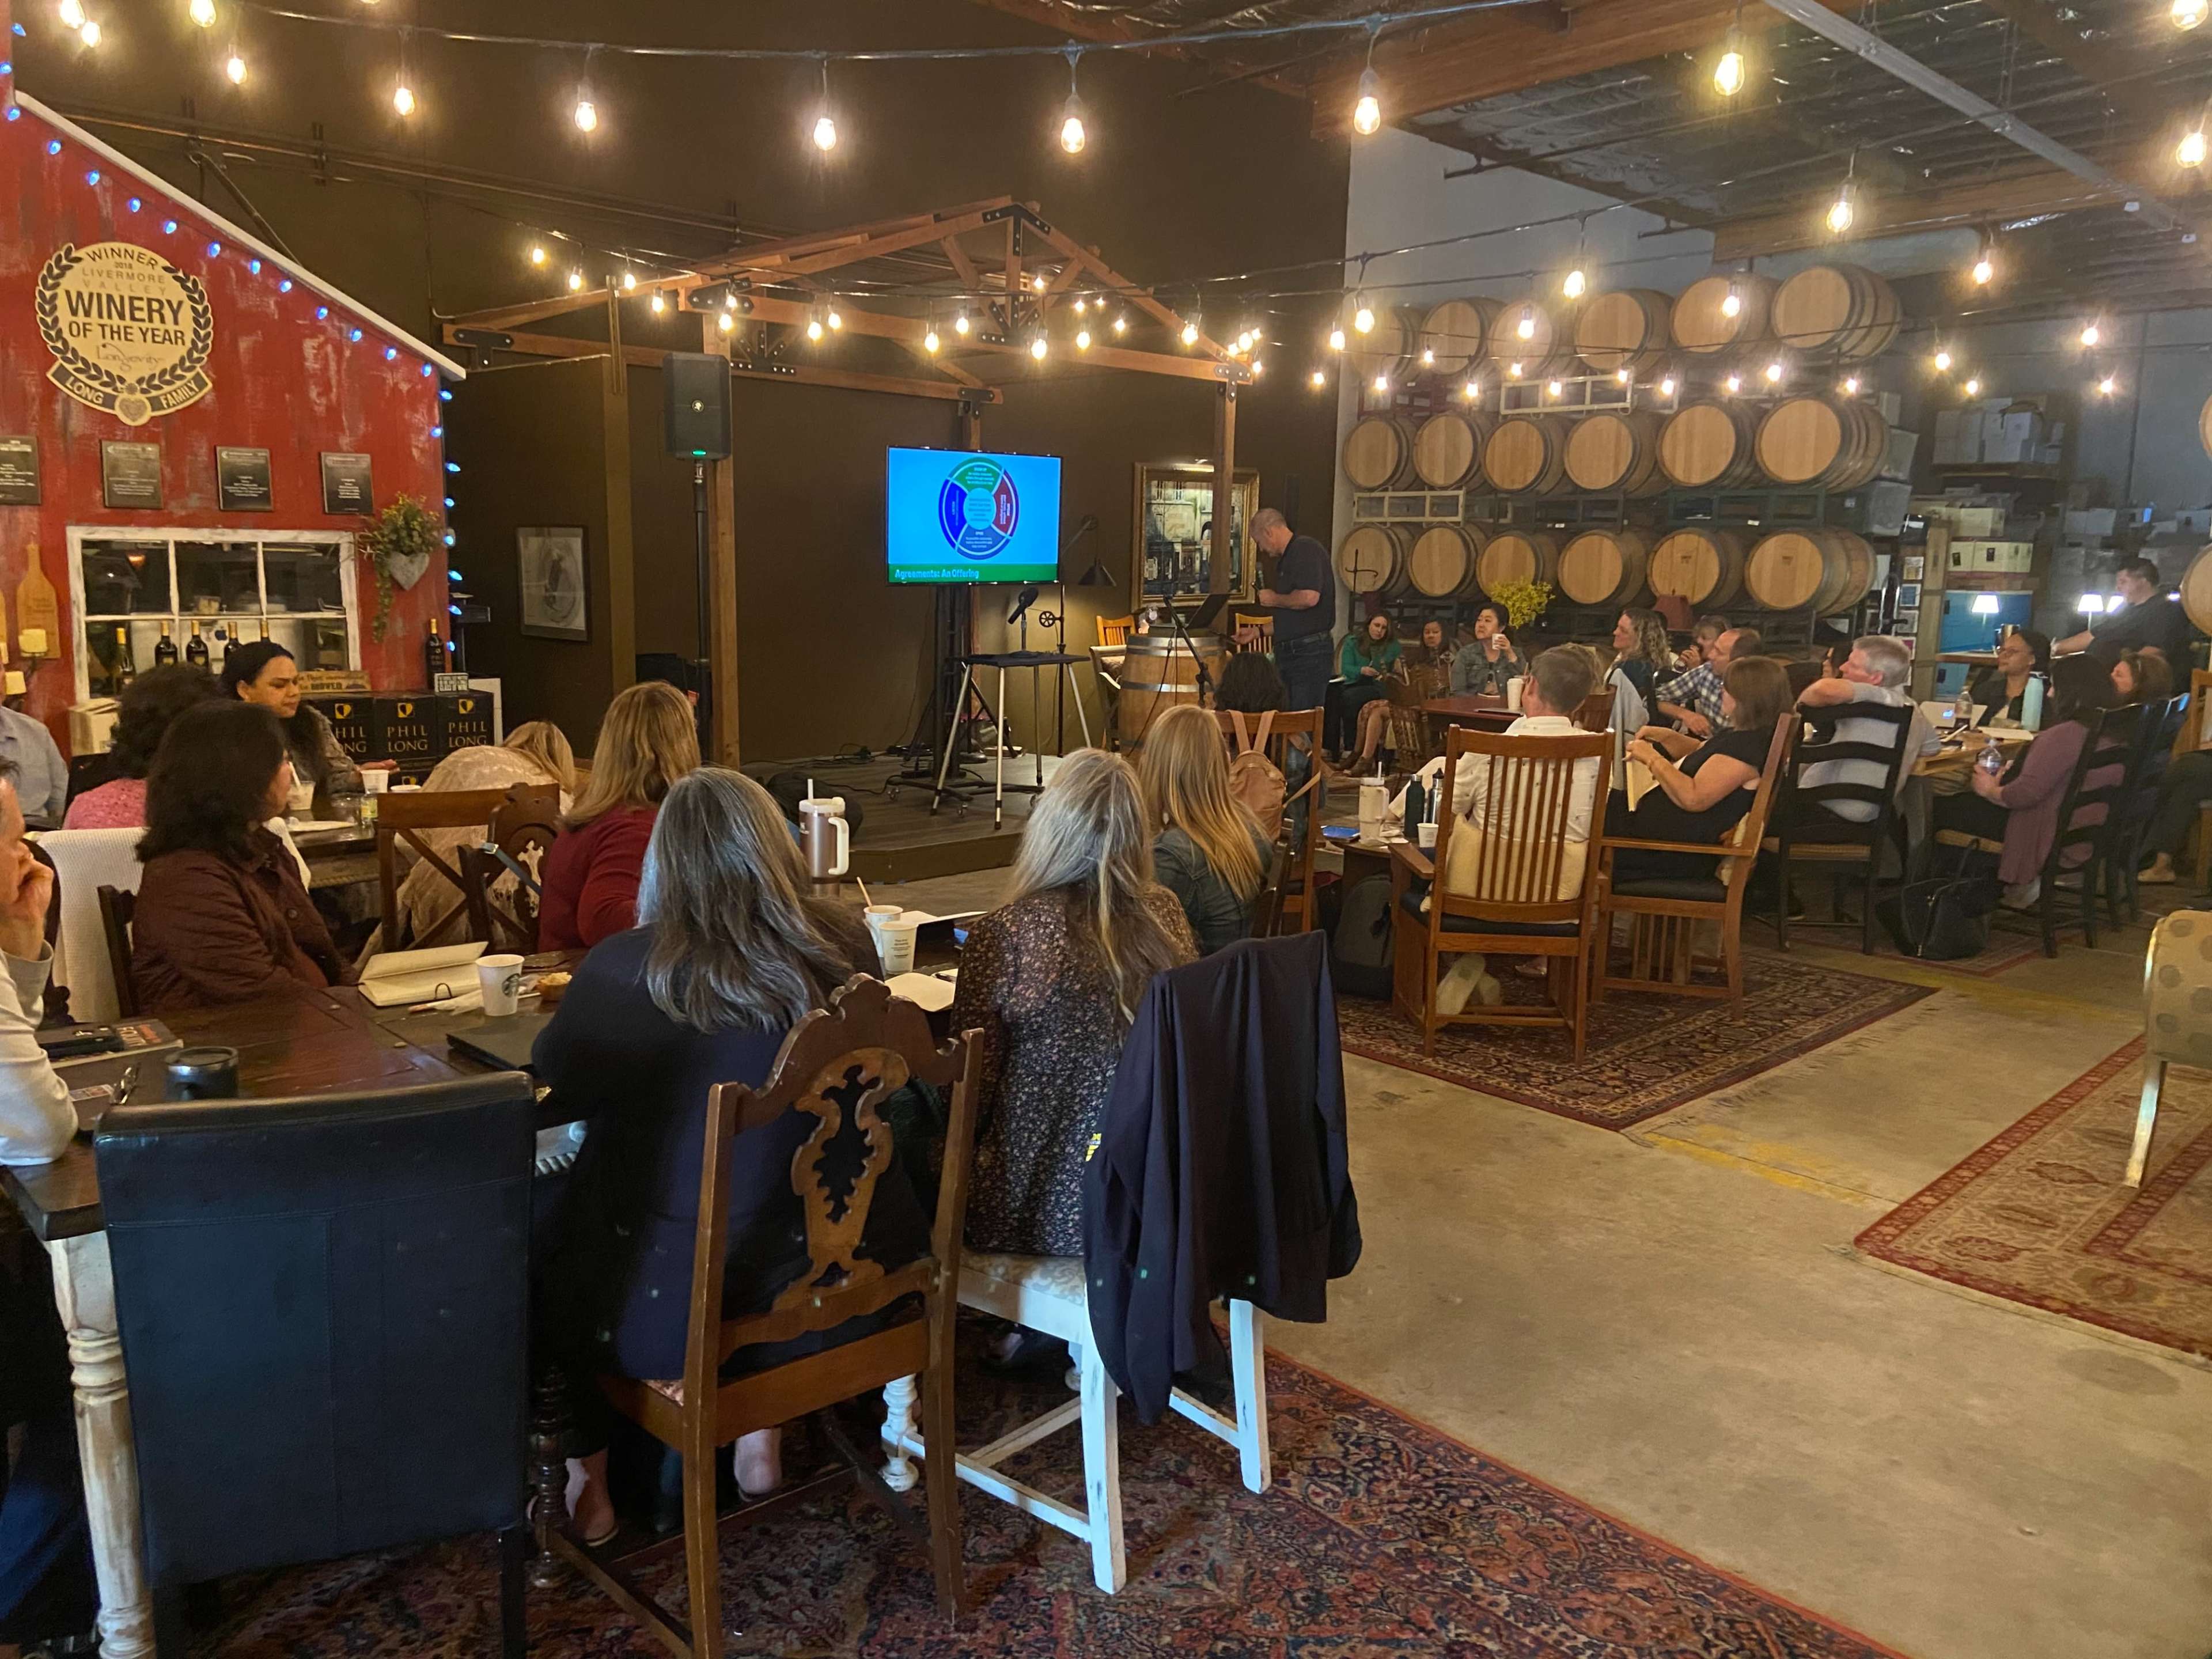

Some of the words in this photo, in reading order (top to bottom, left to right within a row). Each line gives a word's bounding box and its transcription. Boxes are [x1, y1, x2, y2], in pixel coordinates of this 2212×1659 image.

[85, 247, 158, 270] WINNER
[82, 267, 165, 283] LIVERMORE
[82, 279, 166, 296] VALLEY
[65, 289, 184, 325] WINERY
[69, 321, 92, 338] OF
[98, 323, 134, 342] THE
[138, 327, 185, 346] YEAR
[65, 376, 104, 404] LONG
[161, 379, 200, 408] FAMILY
[895, 569, 940, 580] Agreements:
[941, 569, 950, 578] An
[952, 569, 979, 579] Offering
[336, 726, 366, 738] HIL
[387, 725, 428, 737] PHIL
[449, 721, 487, 733] PHIL
[387, 739, 428, 752] LONG
[449, 735, 487, 748] LONG
